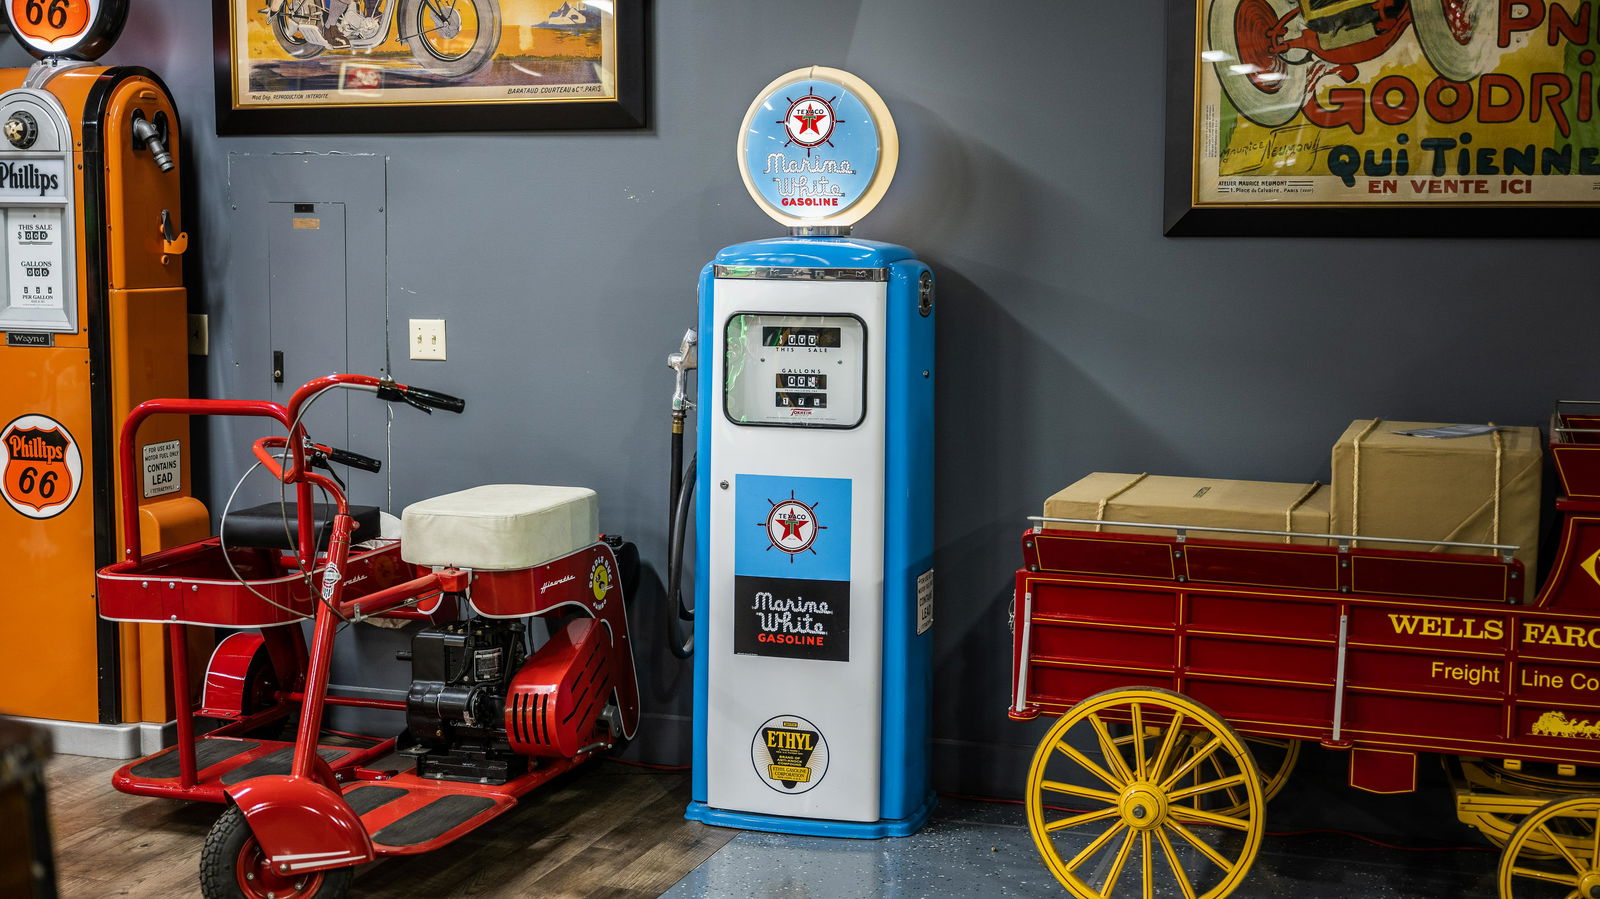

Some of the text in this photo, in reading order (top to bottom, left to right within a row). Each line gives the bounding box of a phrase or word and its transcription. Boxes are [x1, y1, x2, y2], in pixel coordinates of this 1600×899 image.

[26, 0, 70, 29] 66
[1497, 0, 1600, 48] PN
[763, 152, 856, 175] Marine
[0, 162, 58, 196] Phillips
[772, 176, 845, 197] White
[1368, 179, 1532, 194] EN VENTE ICI
[781, 197, 839, 206] GASOLINE
[14, 334, 45, 343] Wayne
[9, 435, 63, 465] Phillips
[147, 460, 177, 473] CONTAINS
[19, 467, 58, 498] 66
[152, 472, 173, 486] LEAD
[752, 592, 833, 615] Marine
[756, 611, 828, 635] White
[1388, 614, 1504, 640] WELLS
[758, 633, 824, 646] GASOLINE
[1431, 661, 1500, 686] Freight
[1521, 669, 1564, 688] Line
[767, 730, 814, 751] ETHYL
